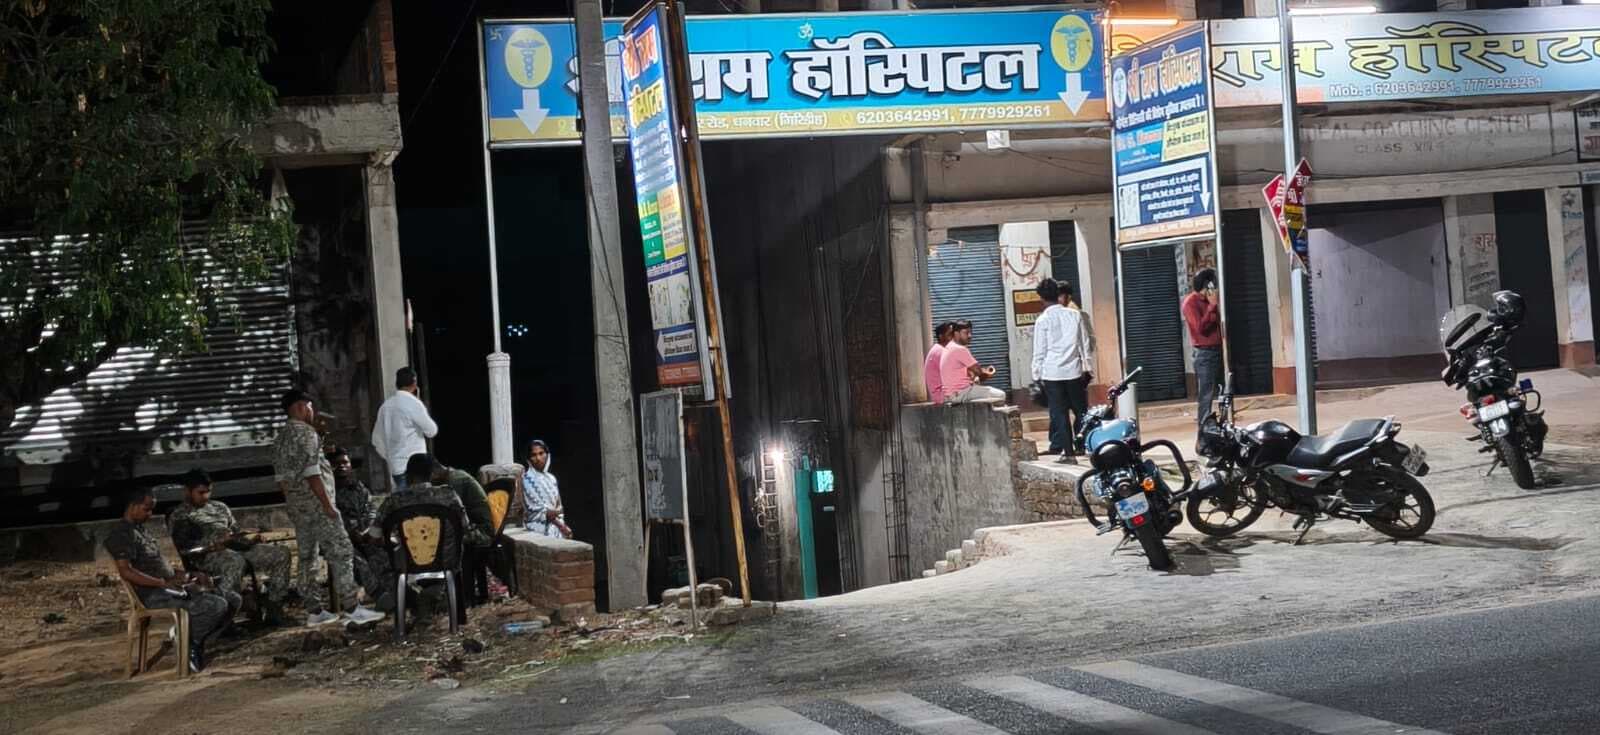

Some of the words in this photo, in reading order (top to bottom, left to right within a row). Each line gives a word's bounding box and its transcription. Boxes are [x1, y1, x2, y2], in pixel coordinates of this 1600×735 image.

[784, 32, 1042, 99] हॉस्पिटल
[1345, 20, 1600, 79] हॉस्पिट
[1140, 62, 1158, 100] राम
[1329, 82, 1364, 97] Mob.
[1463, 76, 1543, 91] 7779929261
[856, 105, 956, 124] 6203642991,
[959, 105, 1052, 120] 7779929261
